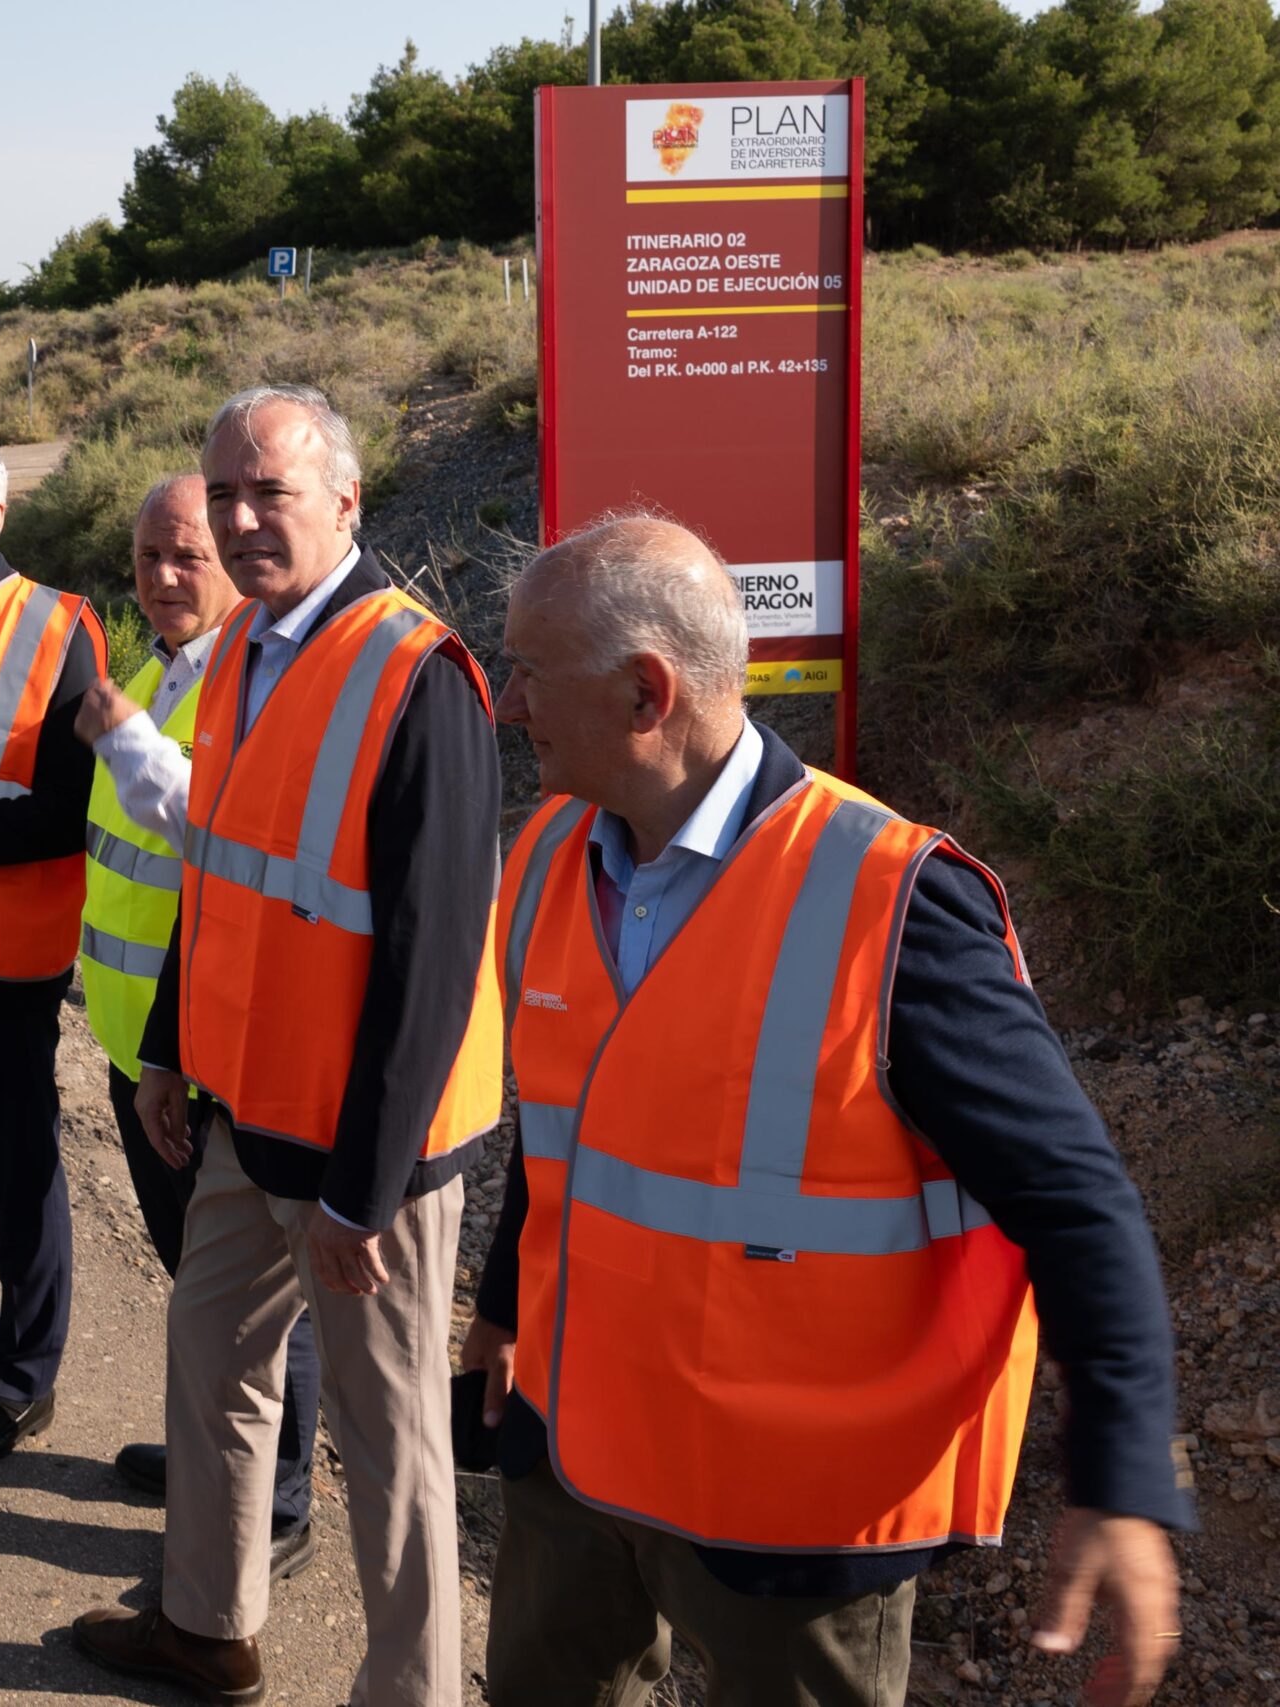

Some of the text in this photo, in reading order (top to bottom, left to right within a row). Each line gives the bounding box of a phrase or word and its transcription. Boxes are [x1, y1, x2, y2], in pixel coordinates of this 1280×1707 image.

[731, 104, 826, 136] PLAN
[731, 136, 826, 147] EXTRAORDINARIO
[731, 146, 826, 159] DE INVERSIONES
[731, 158, 826, 170] EN CARRETERAS
[626, 232, 746, 250] ITINERARIO 02
[274, 251, 290, 273] P
[626, 254, 781, 272] ZARAGOZA OESTE
[627, 272, 842, 295] UNIDAD DE EJECUCIÓN 05
[627, 325, 738, 341] Carretera A-122
[627, 346, 677, 359] Tramo:
[627, 359, 828, 378] Del P.K. 0+000 al P.K. 42+135
[740, 574, 799, 592] IERNO
[744, 592, 813, 610] RAGON
